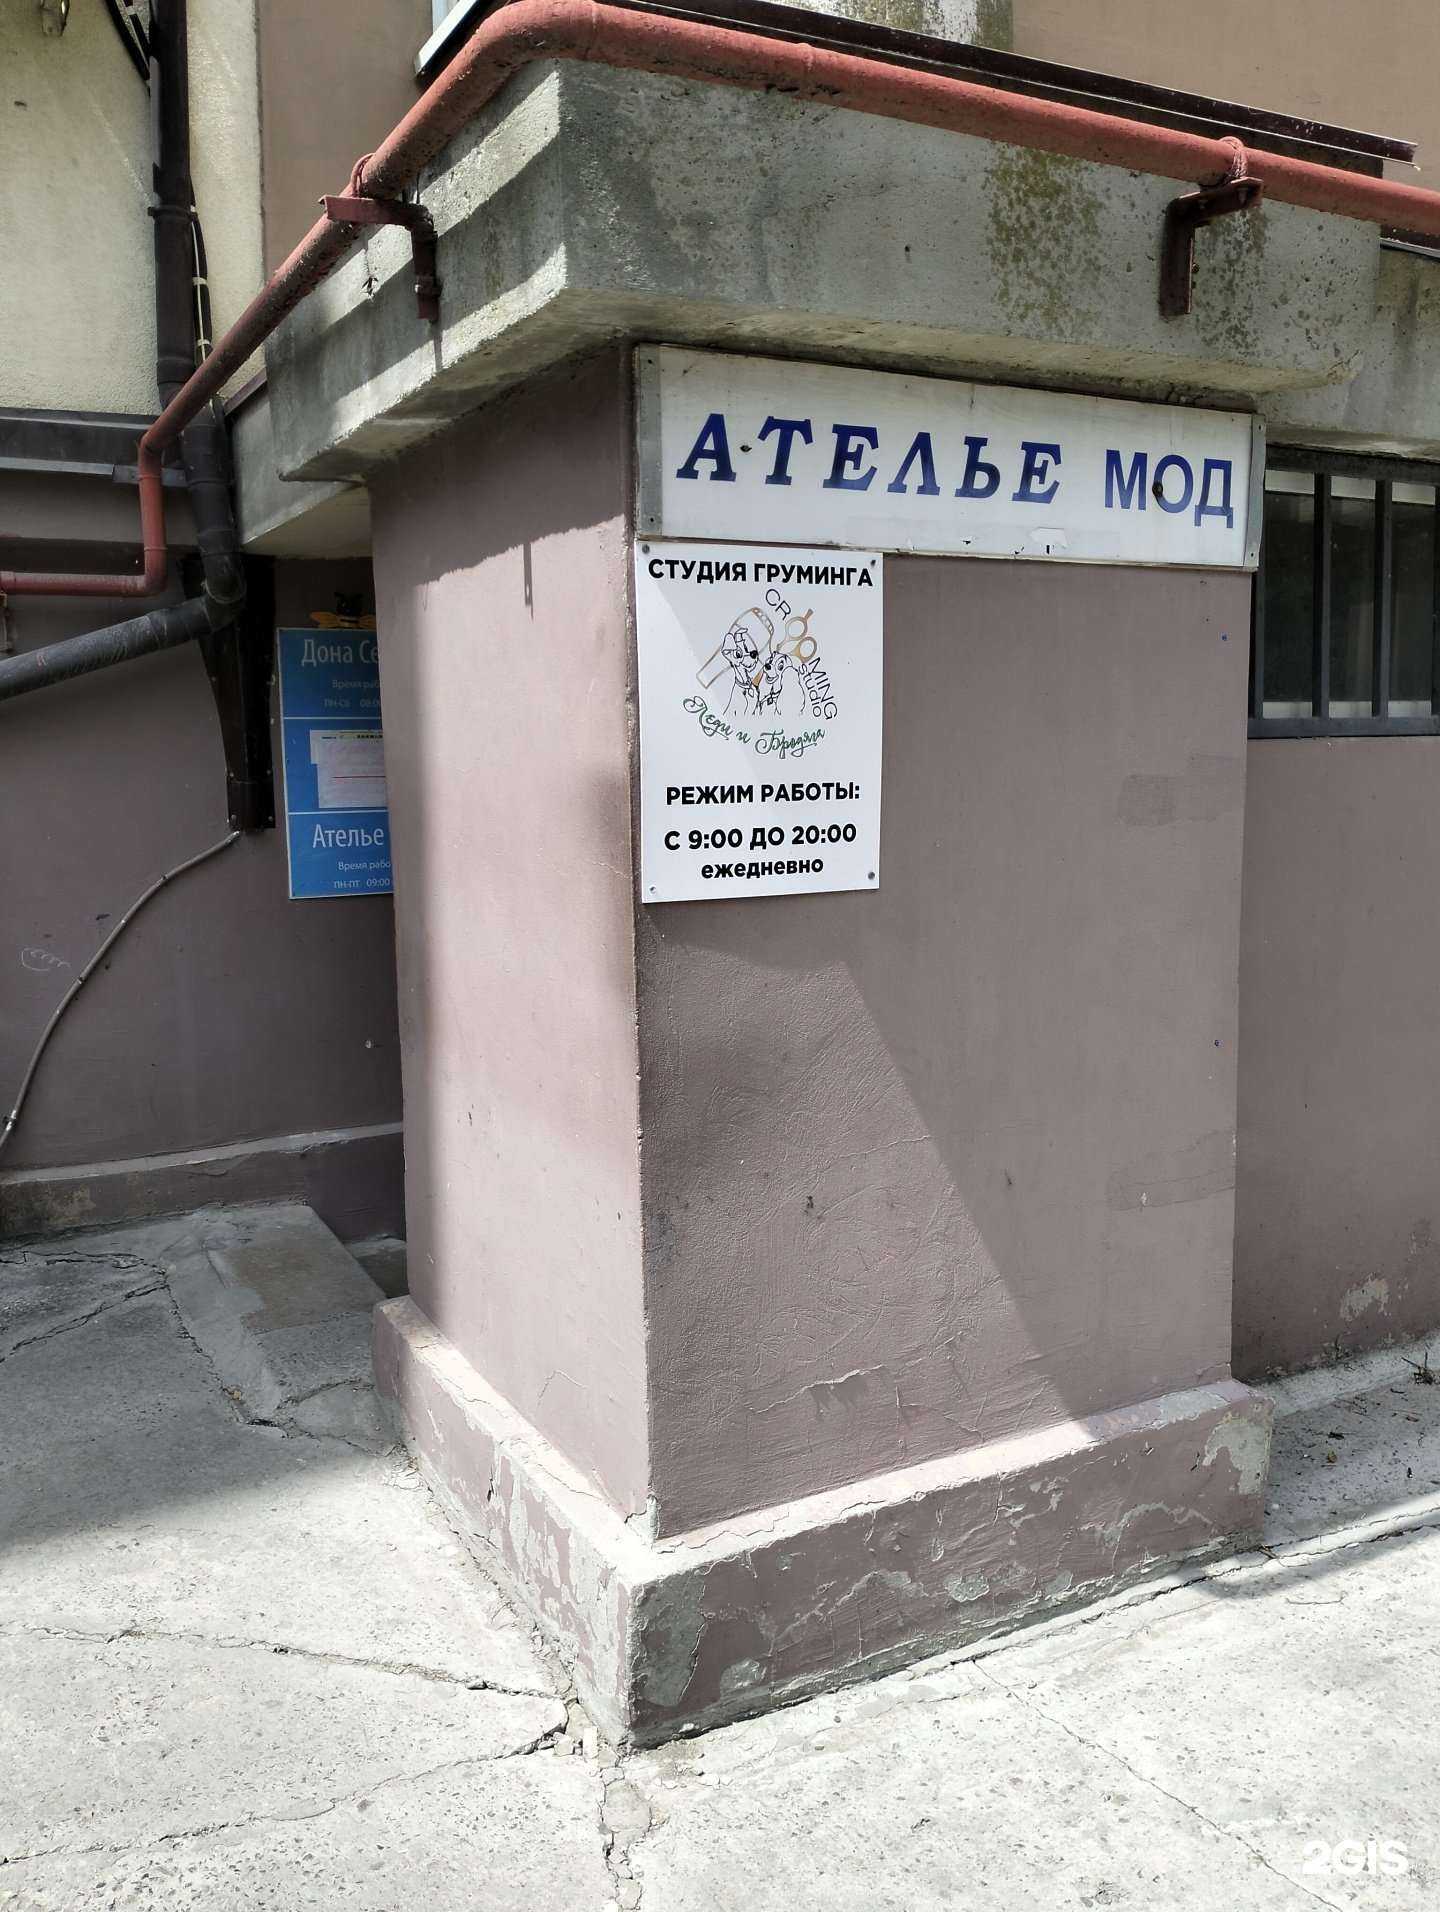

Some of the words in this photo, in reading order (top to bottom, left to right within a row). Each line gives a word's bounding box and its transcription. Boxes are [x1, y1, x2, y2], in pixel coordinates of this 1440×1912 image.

[676, 413, 1062, 504] АТЕЛЬЕ
[1105, 449, 1234, 529] МОД
[648, 559, 747, 584] СТУДИЯ
[754, 563, 873, 587] ГРУМИНГА
[301, 638, 353, 667] Дона
[799, 663, 822, 717] studio
[683, 695, 733, 740] Леди
[736, 731, 751, 744] и
[755, 728, 825, 760] Бродяга
[666, 784, 754, 805] РЕЖИМ
[760, 782, 860, 802] РАБОТЫ:
[312, 823, 385, 849] Ателье
[664, 831, 681, 850] С
[688, 828, 743, 850] 9:00
[750, 826, 785, 850] ДО
[791, 823, 857, 845] 20:00
[338, 861, 367, 872] Время
[701, 858, 824, 879] ежедневно
